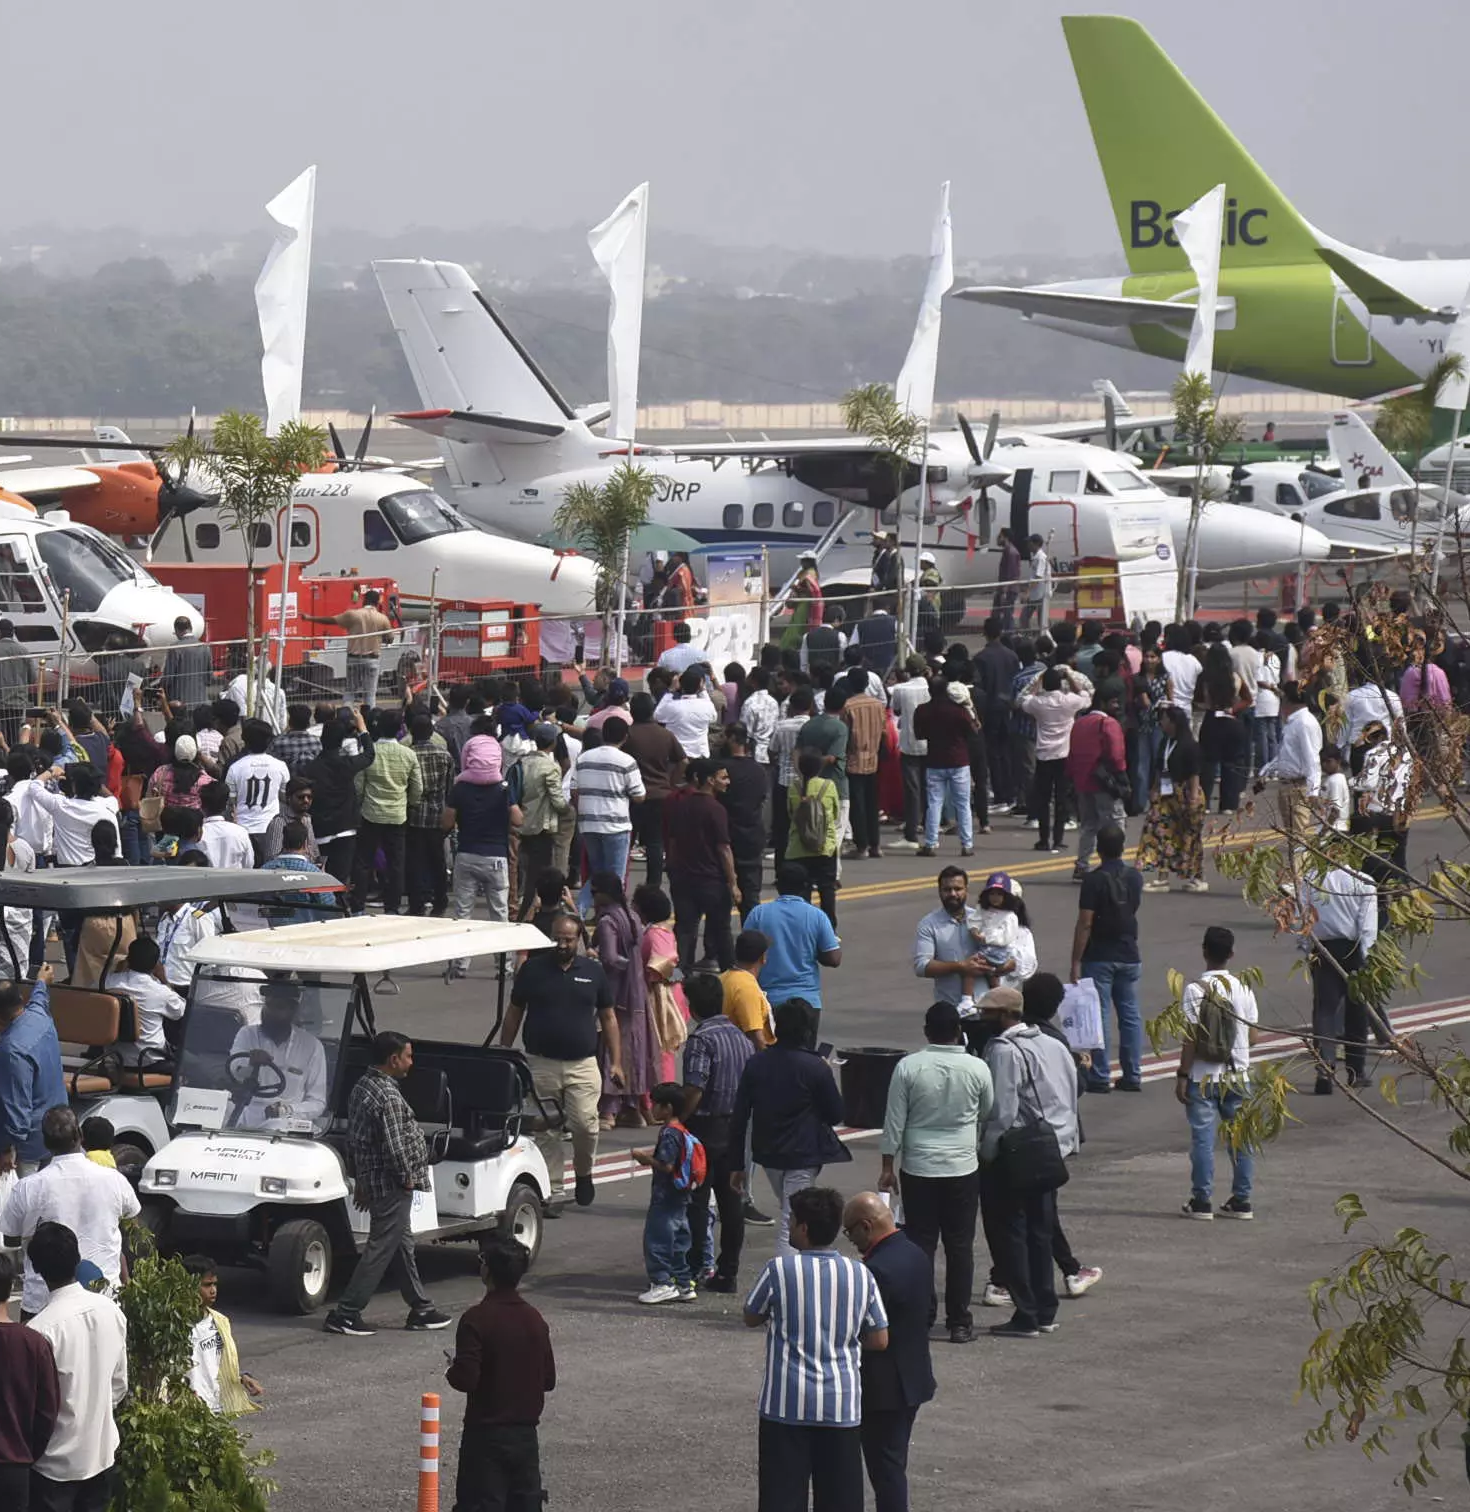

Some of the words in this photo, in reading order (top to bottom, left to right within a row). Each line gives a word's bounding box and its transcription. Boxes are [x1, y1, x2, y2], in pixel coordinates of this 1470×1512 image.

[1131, 198, 1268, 248] Baic
[204, 1146, 266, 1156] MAINI
[189, 1171, 238, 1181] MAINI
